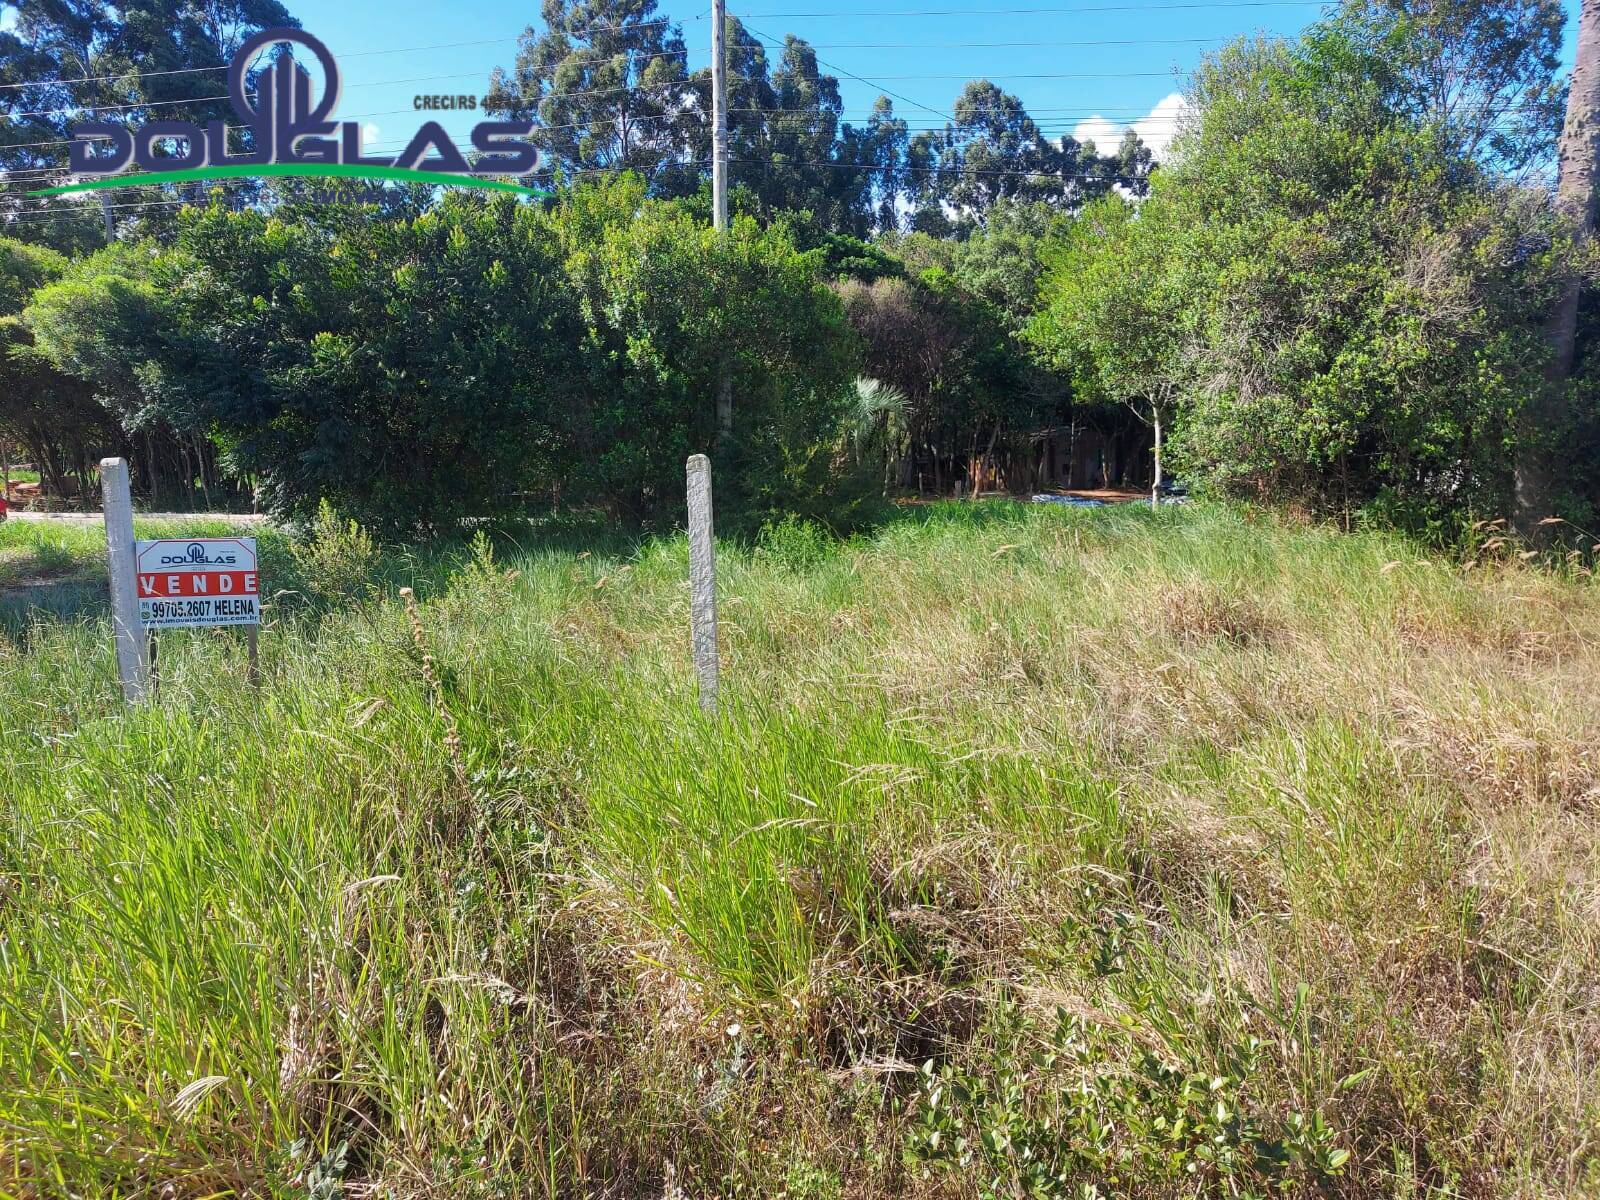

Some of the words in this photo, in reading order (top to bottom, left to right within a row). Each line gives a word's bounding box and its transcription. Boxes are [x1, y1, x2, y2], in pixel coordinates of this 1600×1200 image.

[161, 555, 236, 564] DOUGLAS
[140, 574, 257, 595] VENDE
[152, 601, 211, 618] 99705.2607
[214, 600, 255, 615] HELENA
